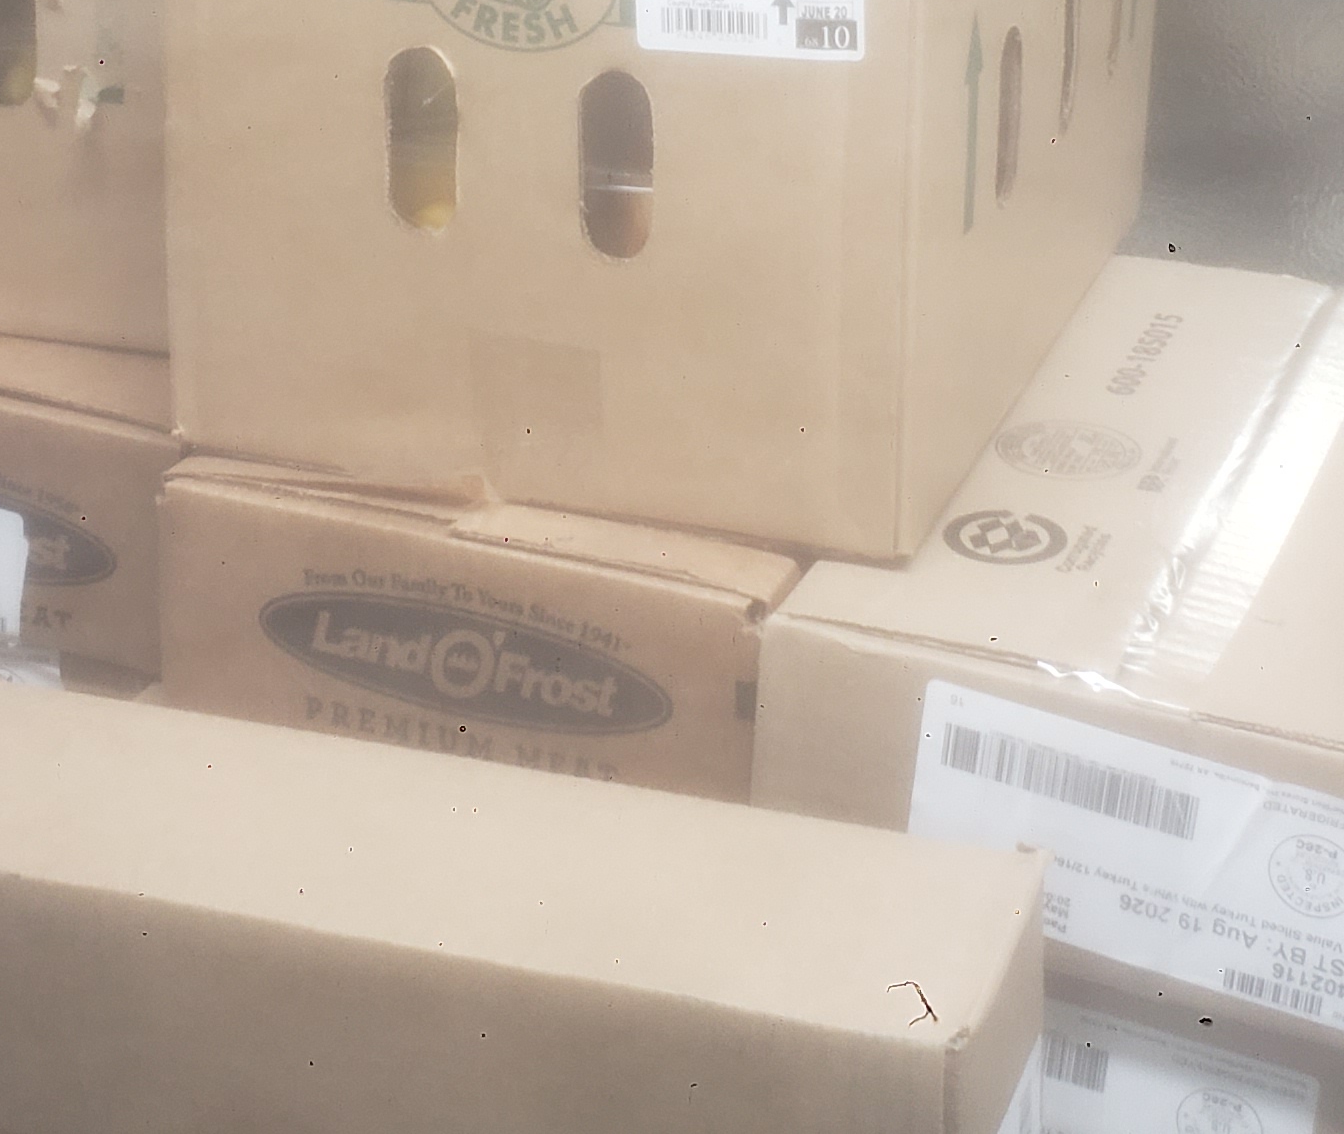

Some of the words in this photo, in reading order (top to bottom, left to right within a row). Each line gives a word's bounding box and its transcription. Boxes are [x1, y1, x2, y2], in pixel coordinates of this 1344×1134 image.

[800, 5, 830, 19] JUNE
[834, 6, 847, 18] 20
[821, 24, 850, 49] 10
[303, 568, 348, 587] From
[352, 569, 385, 589] Our
[392, 572, 447, 598] Family
[452, 582, 475, 602] To
[477, 588, 524, 616] Yours
[531, 602, 576, 632] Since
[311, 610, 432, 673] Land
[305, 696, 493, 761] PREMIUM
[516, 743, 620, 781] MEAT
[1091, 864, 1139, 890] Turkey
[1179, 894, 1208, 912] with
[1270, 870, 1344, 919] INSPECTED
[1116, 892, 1172, 924] 2026
[1209, 901, 1257, 926] Turkey
[1175, 910, 1203, 933] 19
[1208, 917, 1259, 949] Aug
[1258, 917, 1302, 940] Sliced
[1262, 936, 1306, 965] BY:
[1304, 931, 1344, 953] Value
